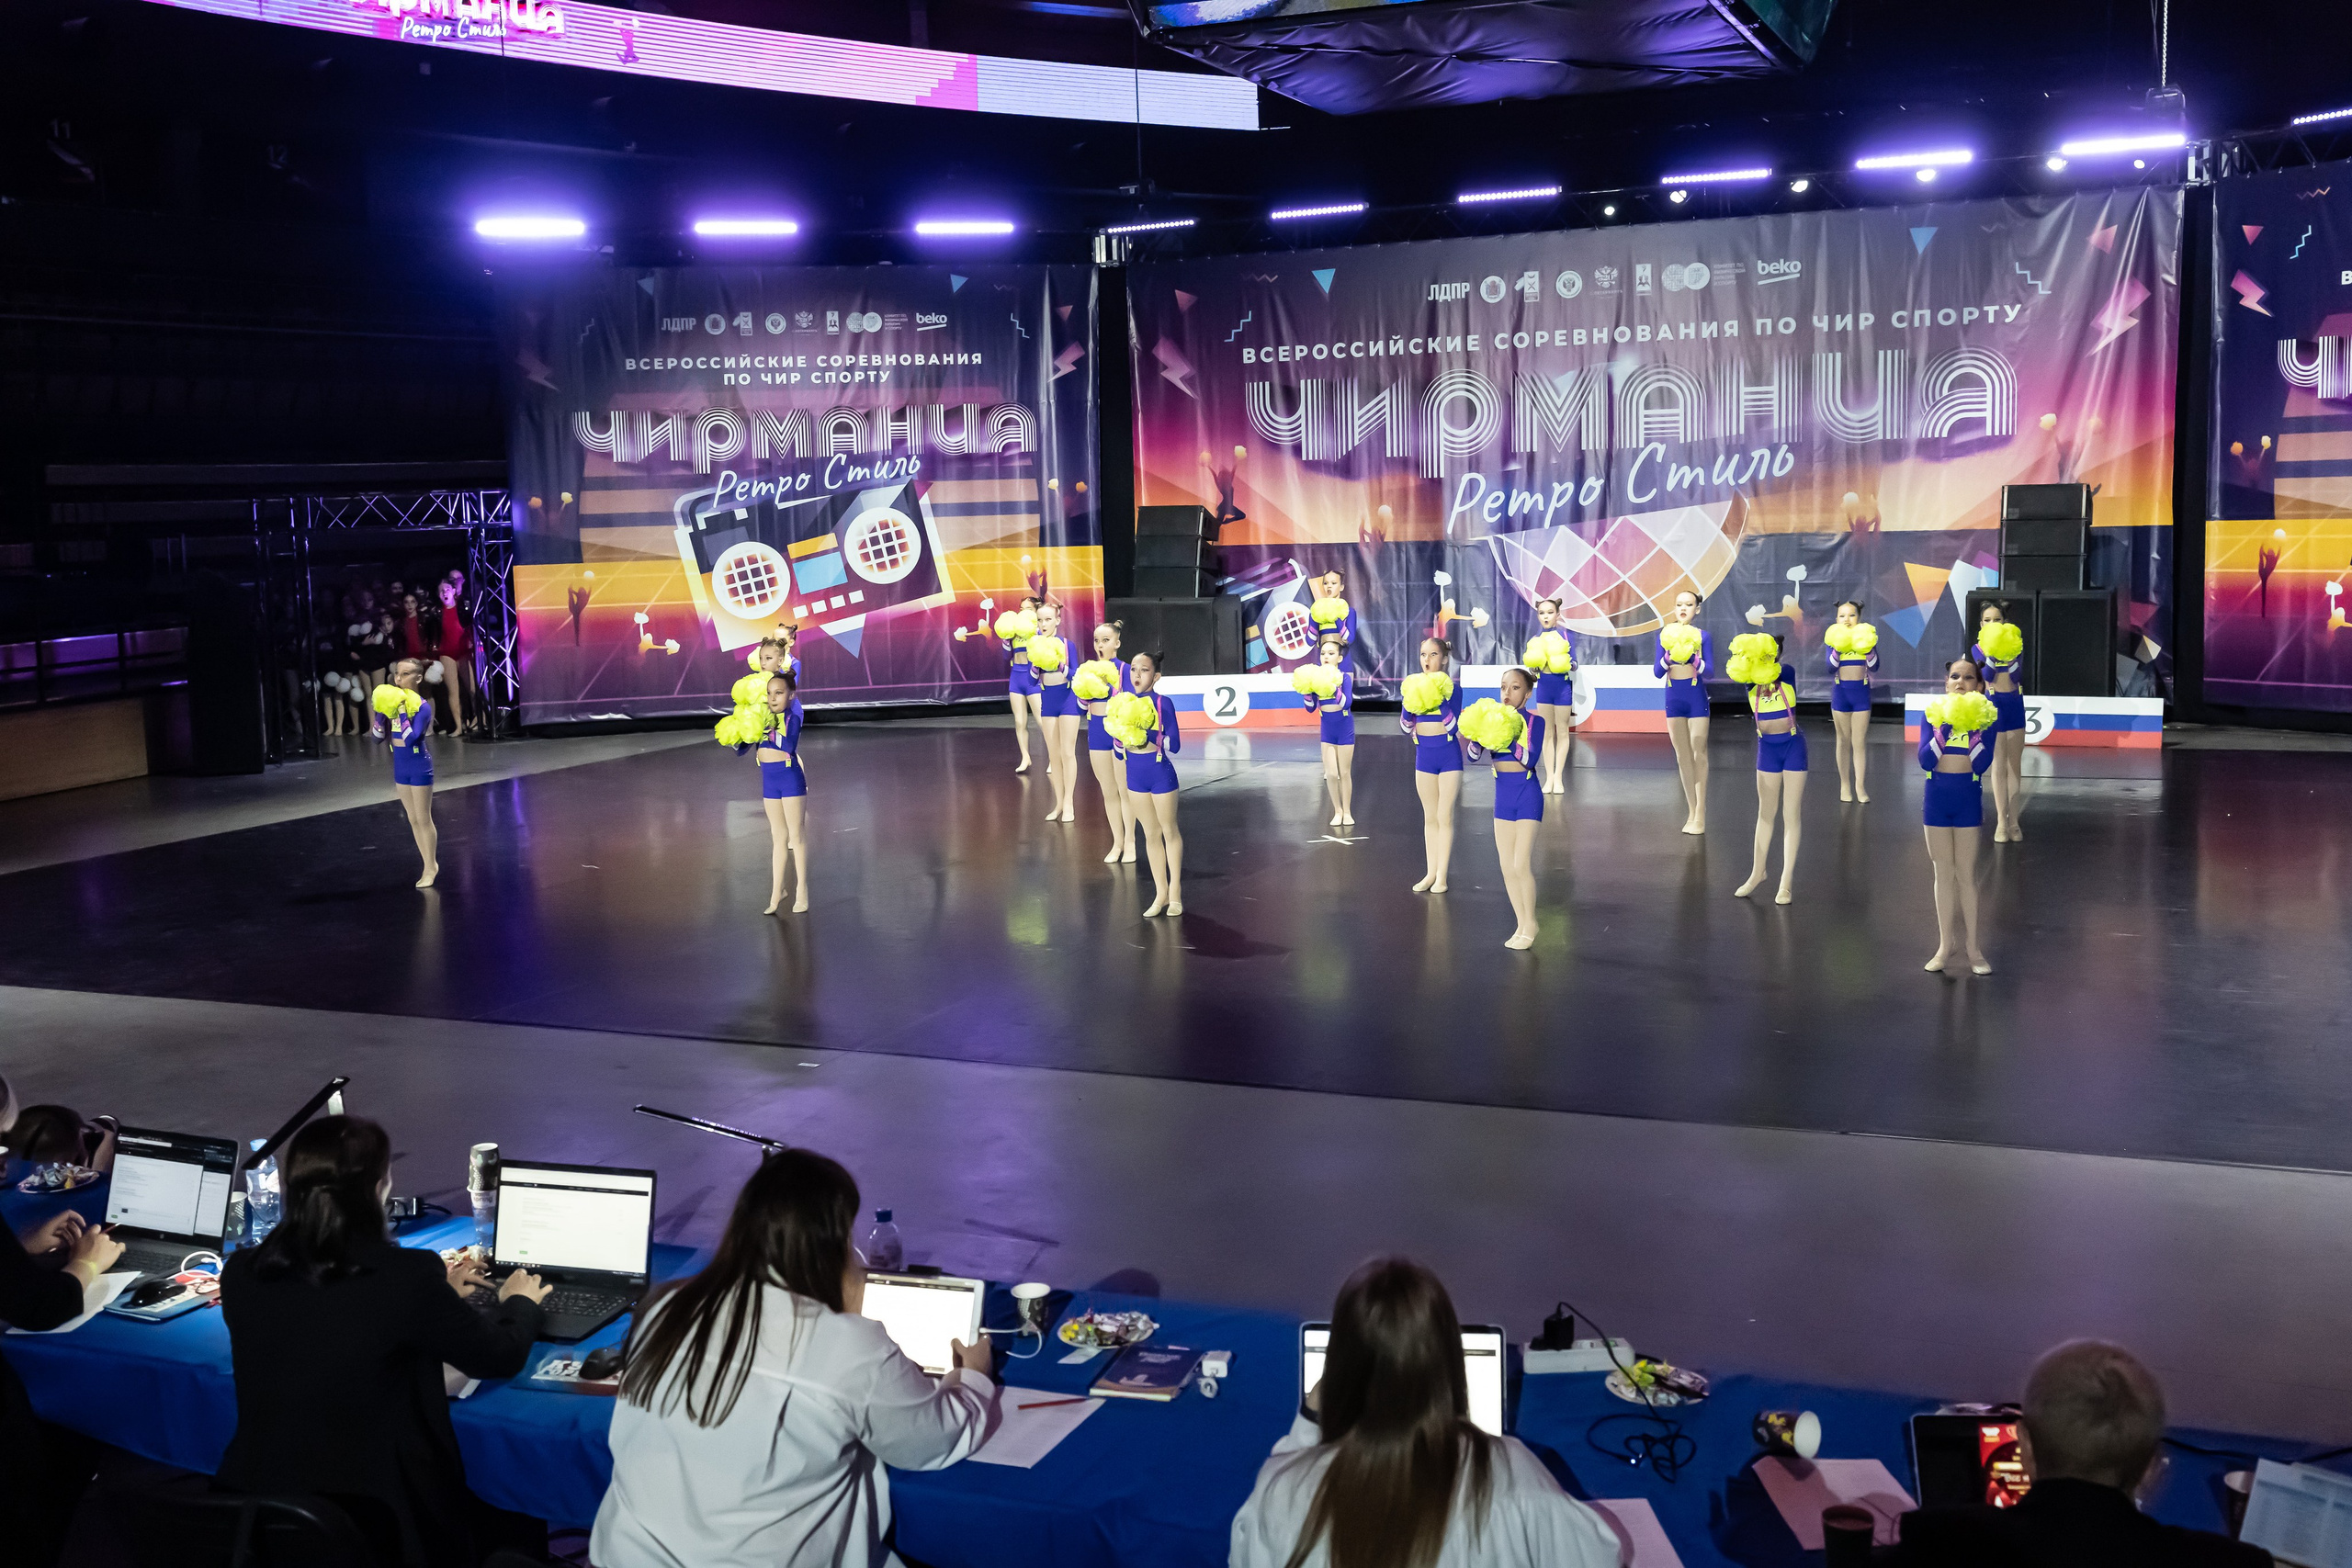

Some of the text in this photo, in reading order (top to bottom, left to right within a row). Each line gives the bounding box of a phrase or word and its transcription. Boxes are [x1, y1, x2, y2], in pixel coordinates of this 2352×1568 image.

[401, 17, 452, 42] Ретро
[1757, 259, 1802, 275] beko
[1428, 282, 1470, 302] ЛДПР
[661, 318, 697, 332] ЛДПР
[916, 312, 947, 324] beko
[1242, 304, 2022, 364] ВСЕРОССИЙСКИЕ СОРЕВНОВАНИЯ ПО ЧИР СПОРТУ
[625, 353, 983, 370] ВСЕРОССИЙСКИЕ СОРЕВНОВАНИЯ
[723, 371, 891, 386] ПО ЧИР СПОРТУ
[713, 453, 921, 508] Ретро Стиль
[1447, 442, 1794, 535] Ретро Стиль
[1215, 686, 1238, 717] 2
[2024, 706, 2042, 735] 3
